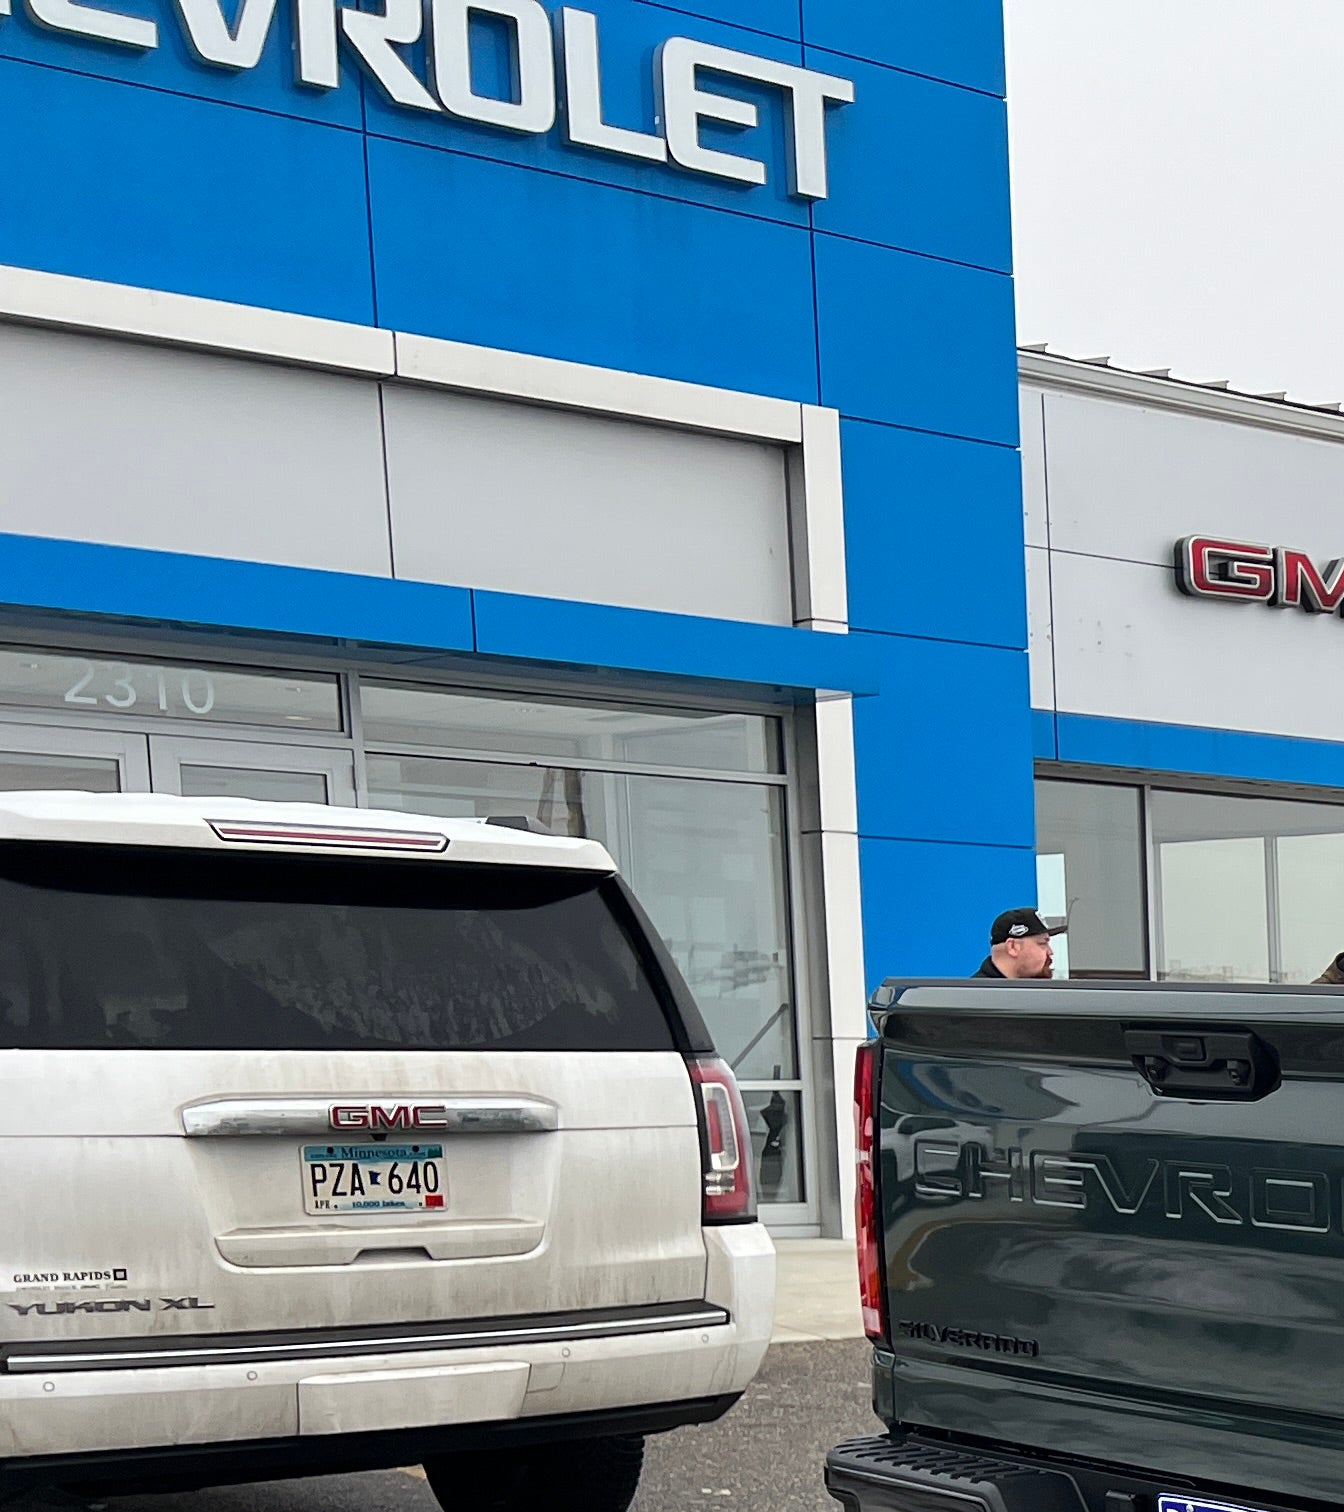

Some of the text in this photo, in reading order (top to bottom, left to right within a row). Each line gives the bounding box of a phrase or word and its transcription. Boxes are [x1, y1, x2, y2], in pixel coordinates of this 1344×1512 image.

[0, 0, 854, 199] VROLET
[64, 657, 215, 714] 2310
[328, 1104, 448, 1129] GMC
[341, 1147, 407, 1160] Minnesota
[310, 1161, 439, 1198] PZA 640
[13, 1271, 112, 1282] GRAND RAPIDS
[7, 1296, 216, 1316] YUKON XL
